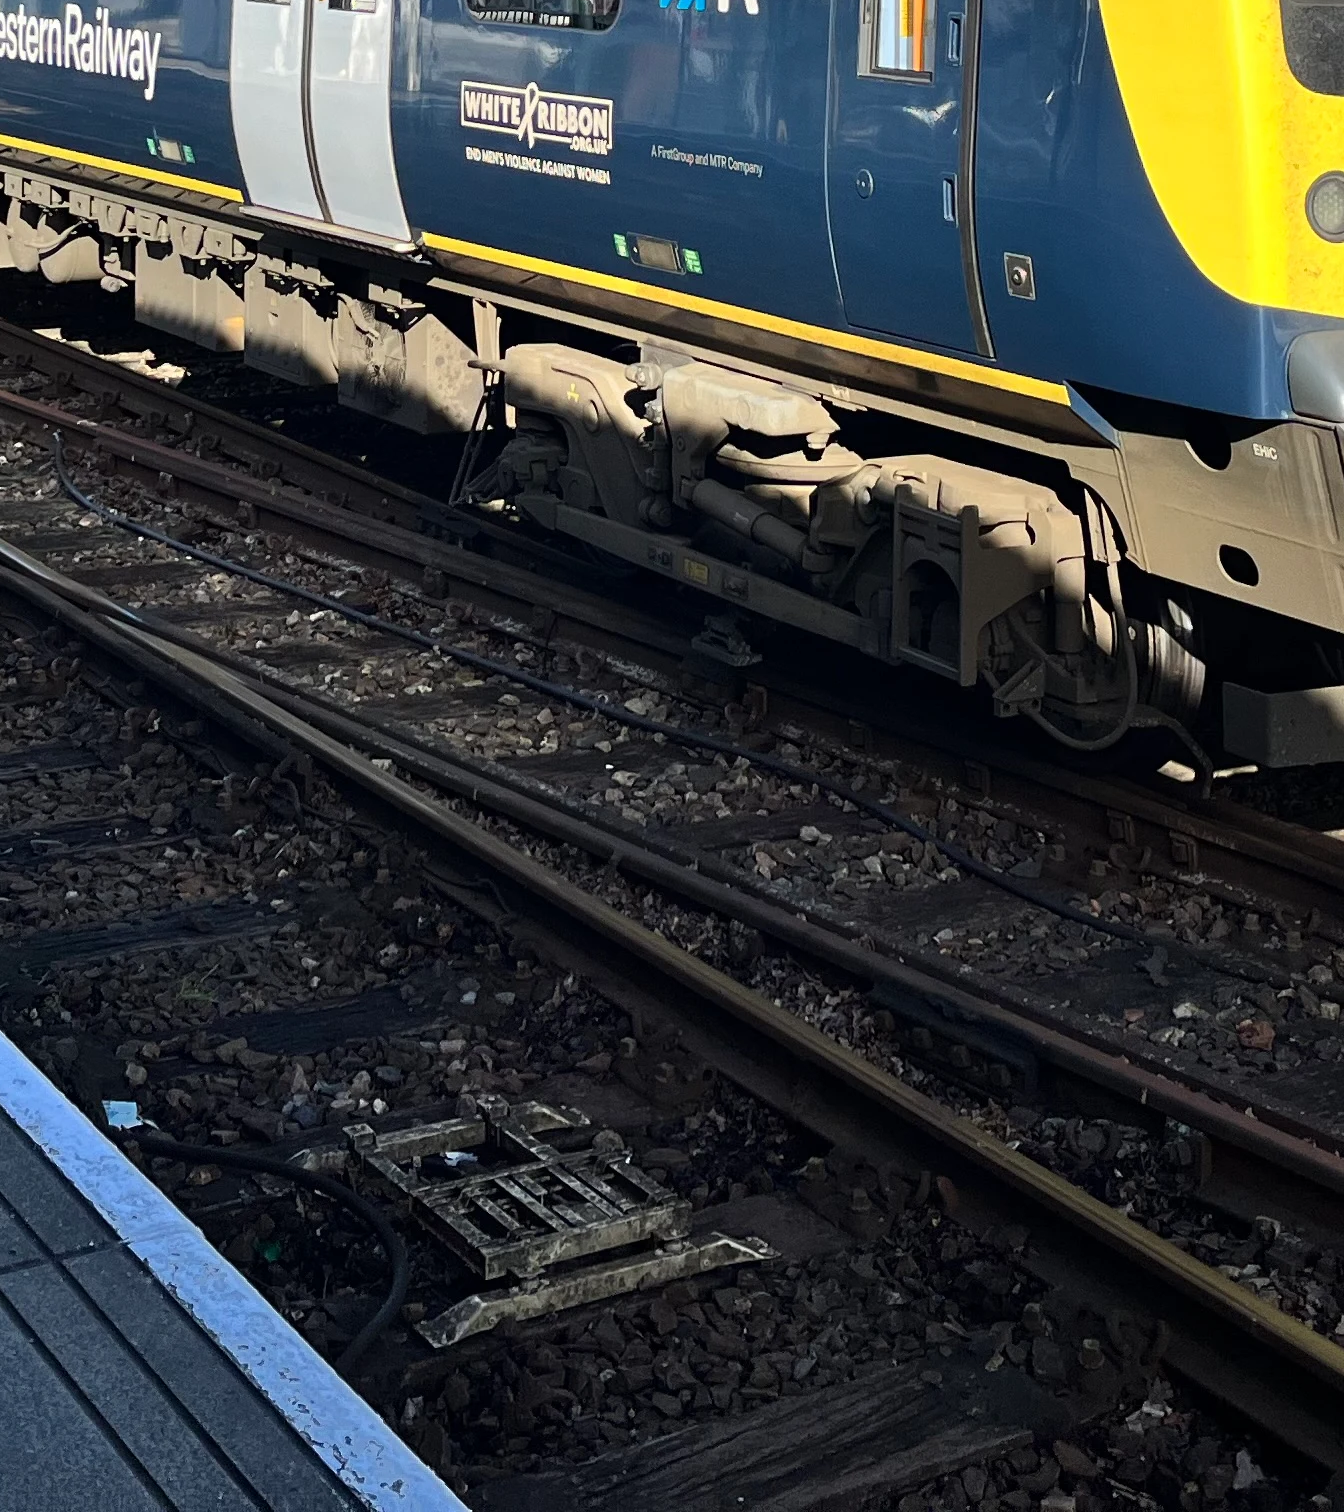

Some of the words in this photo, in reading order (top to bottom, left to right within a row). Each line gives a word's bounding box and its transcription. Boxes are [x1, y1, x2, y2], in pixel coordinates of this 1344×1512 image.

[464, 90, 521, 125] WHITE
[537, 100, 608, 138] RIBBON
[465, 146, 482, 161] END
[482, 149, 505, 167] MEN'S
[505, 152, 542, 174] VIOLENCE
[542, 159, 576, 180] AGAINST
[576, 165, 611, 185] WOMEN
[651, 144, 657, 157] A
[695, 153, 709, 166] and
[710, 153, 727, 169] MTR
[727, 156, 763, 178] Company
